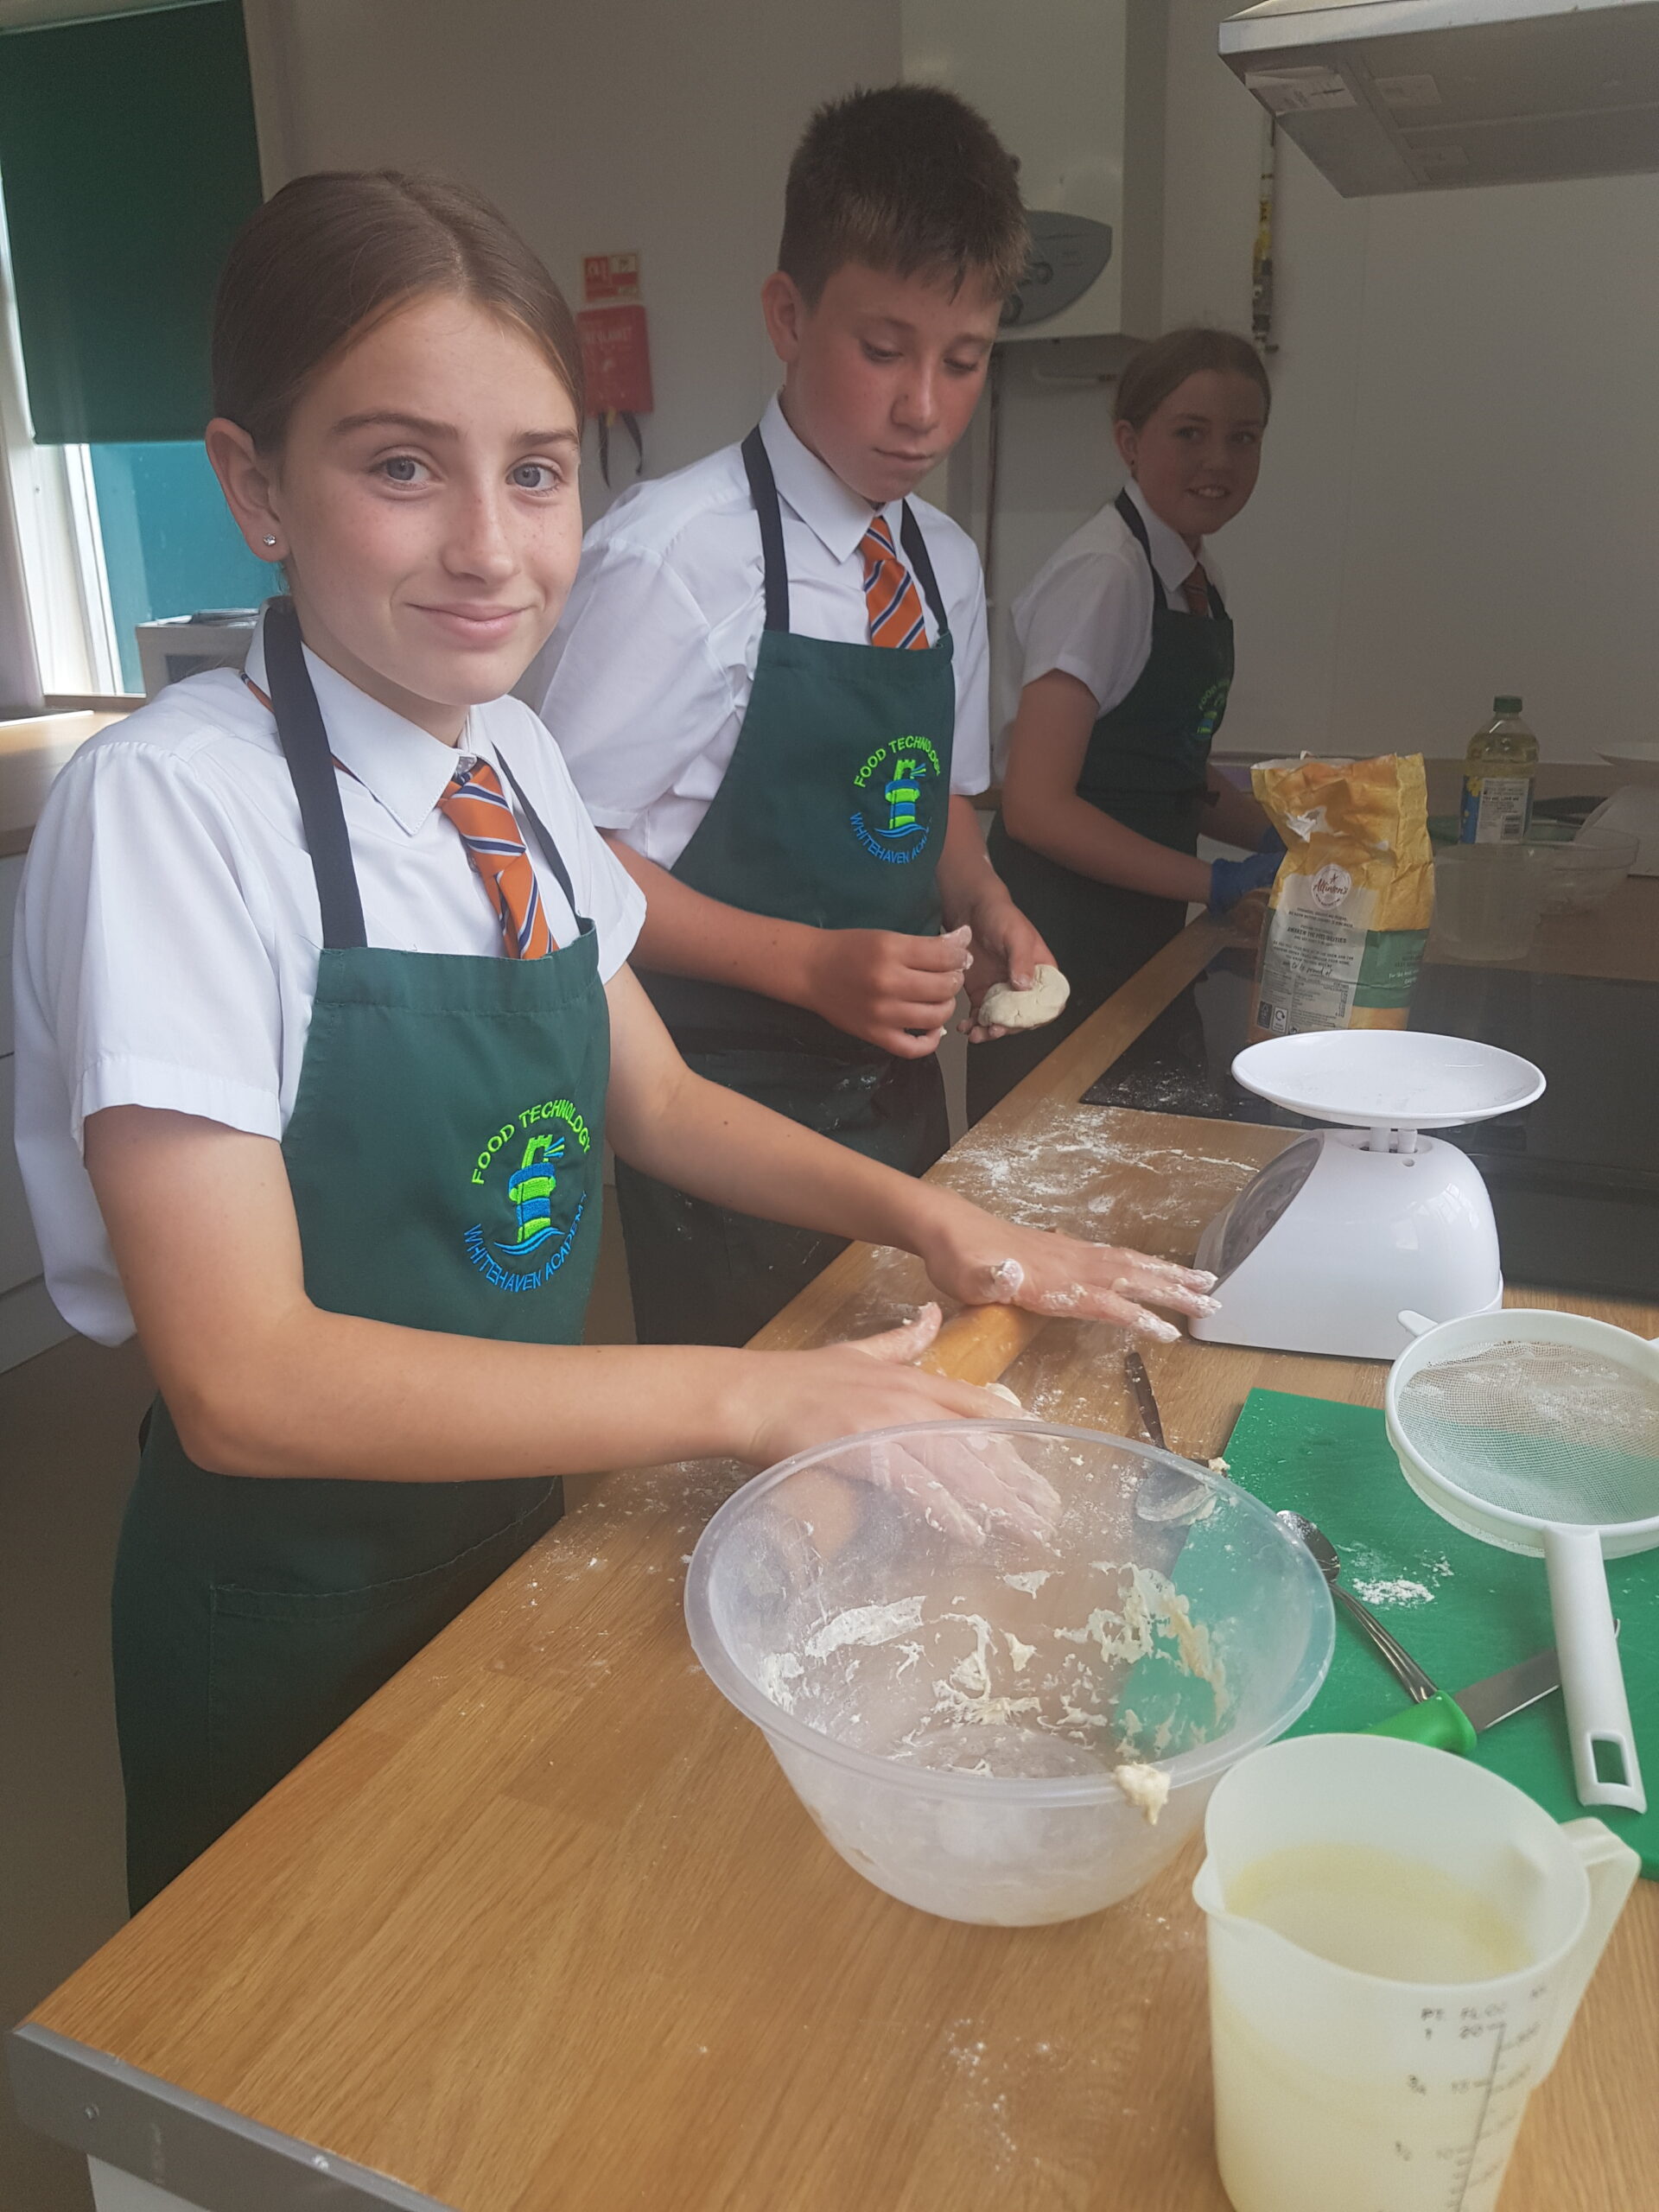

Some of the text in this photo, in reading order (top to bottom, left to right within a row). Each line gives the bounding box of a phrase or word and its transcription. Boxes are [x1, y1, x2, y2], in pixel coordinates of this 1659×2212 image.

[853, 747, 887, 788] FOOD
[849, 811, 910, 864] WHITEHAVEN
[472, 1099, 591, 1185] FOOD TECHNOLOGY
[464, 1223, 543, 1293] WHITEHAVEN
